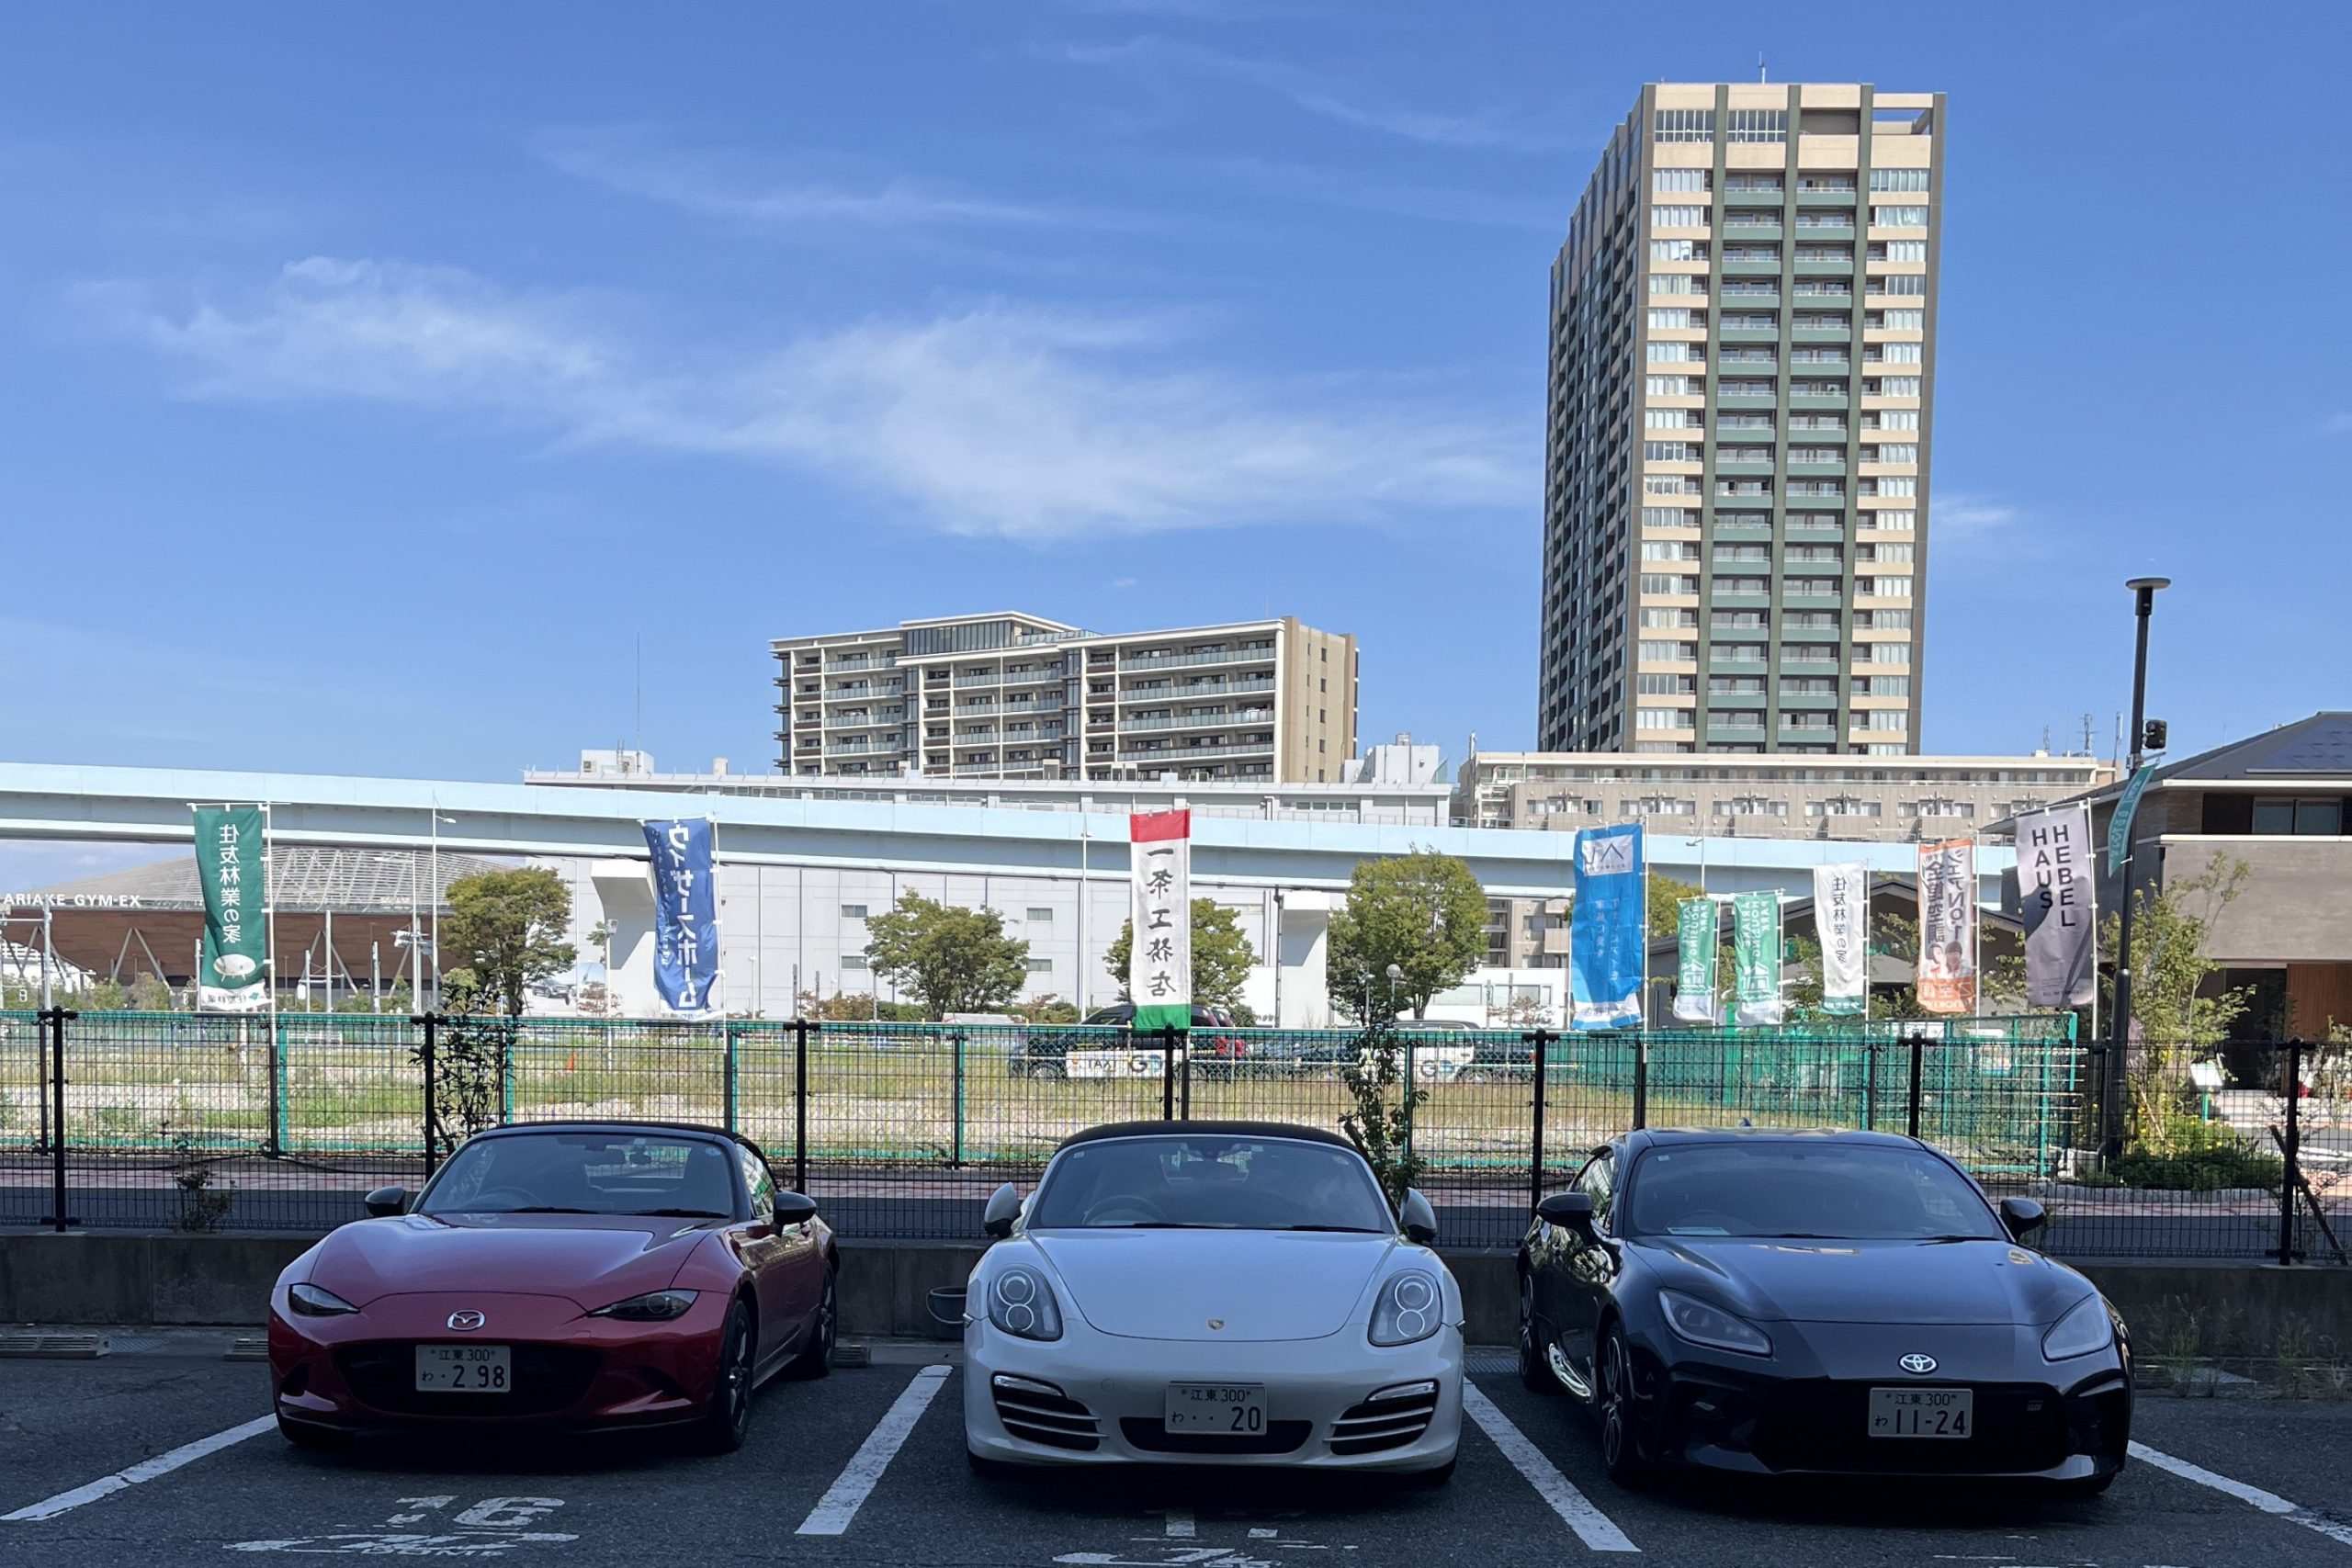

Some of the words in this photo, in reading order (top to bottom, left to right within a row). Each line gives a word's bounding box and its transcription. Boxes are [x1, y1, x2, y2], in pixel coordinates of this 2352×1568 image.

[3, 893, 66, 907] ARIAKE
[74, 894, 142, 908] GYM-EX
[2031, 828, 2053, 909] HAUS
[2052, 824, 2075, 928] HEBEL
